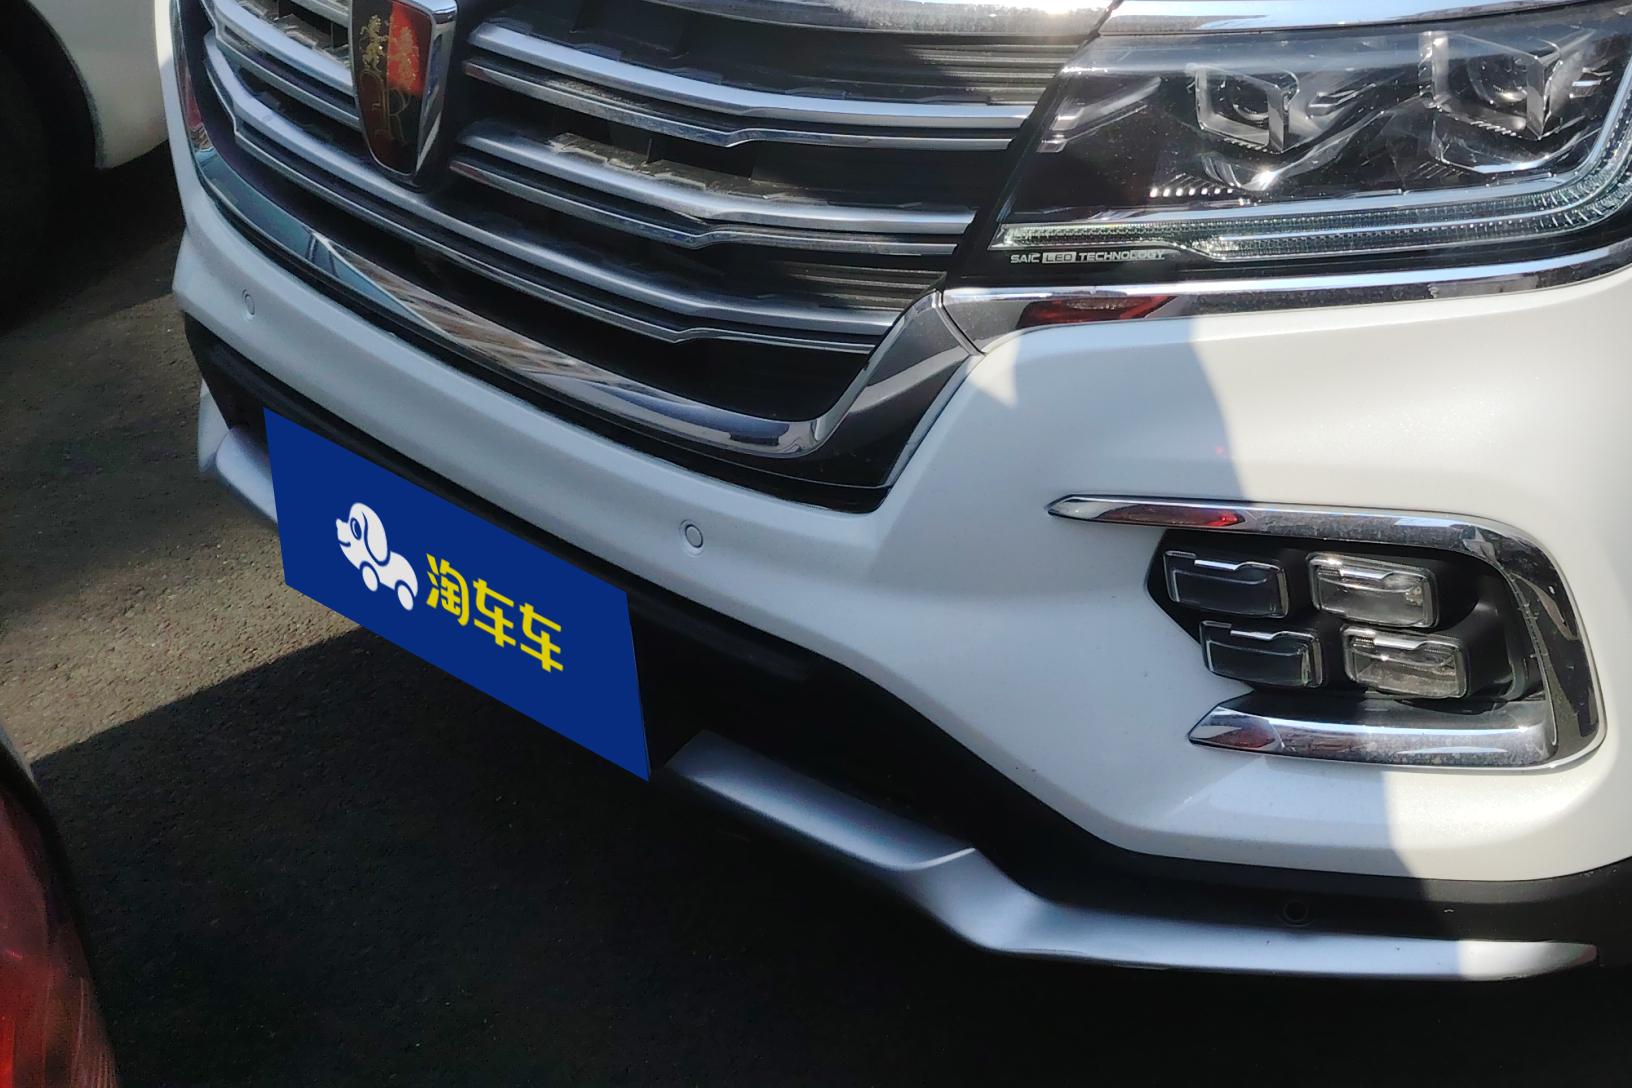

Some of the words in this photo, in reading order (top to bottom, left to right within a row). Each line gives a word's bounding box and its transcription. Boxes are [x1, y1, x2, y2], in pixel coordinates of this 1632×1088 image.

[1010, 253, 1040, 264] SAIC
[1043, 252, 1075, 263] LED
[1079, 250, 1165, 262] TECHNOLOGY
